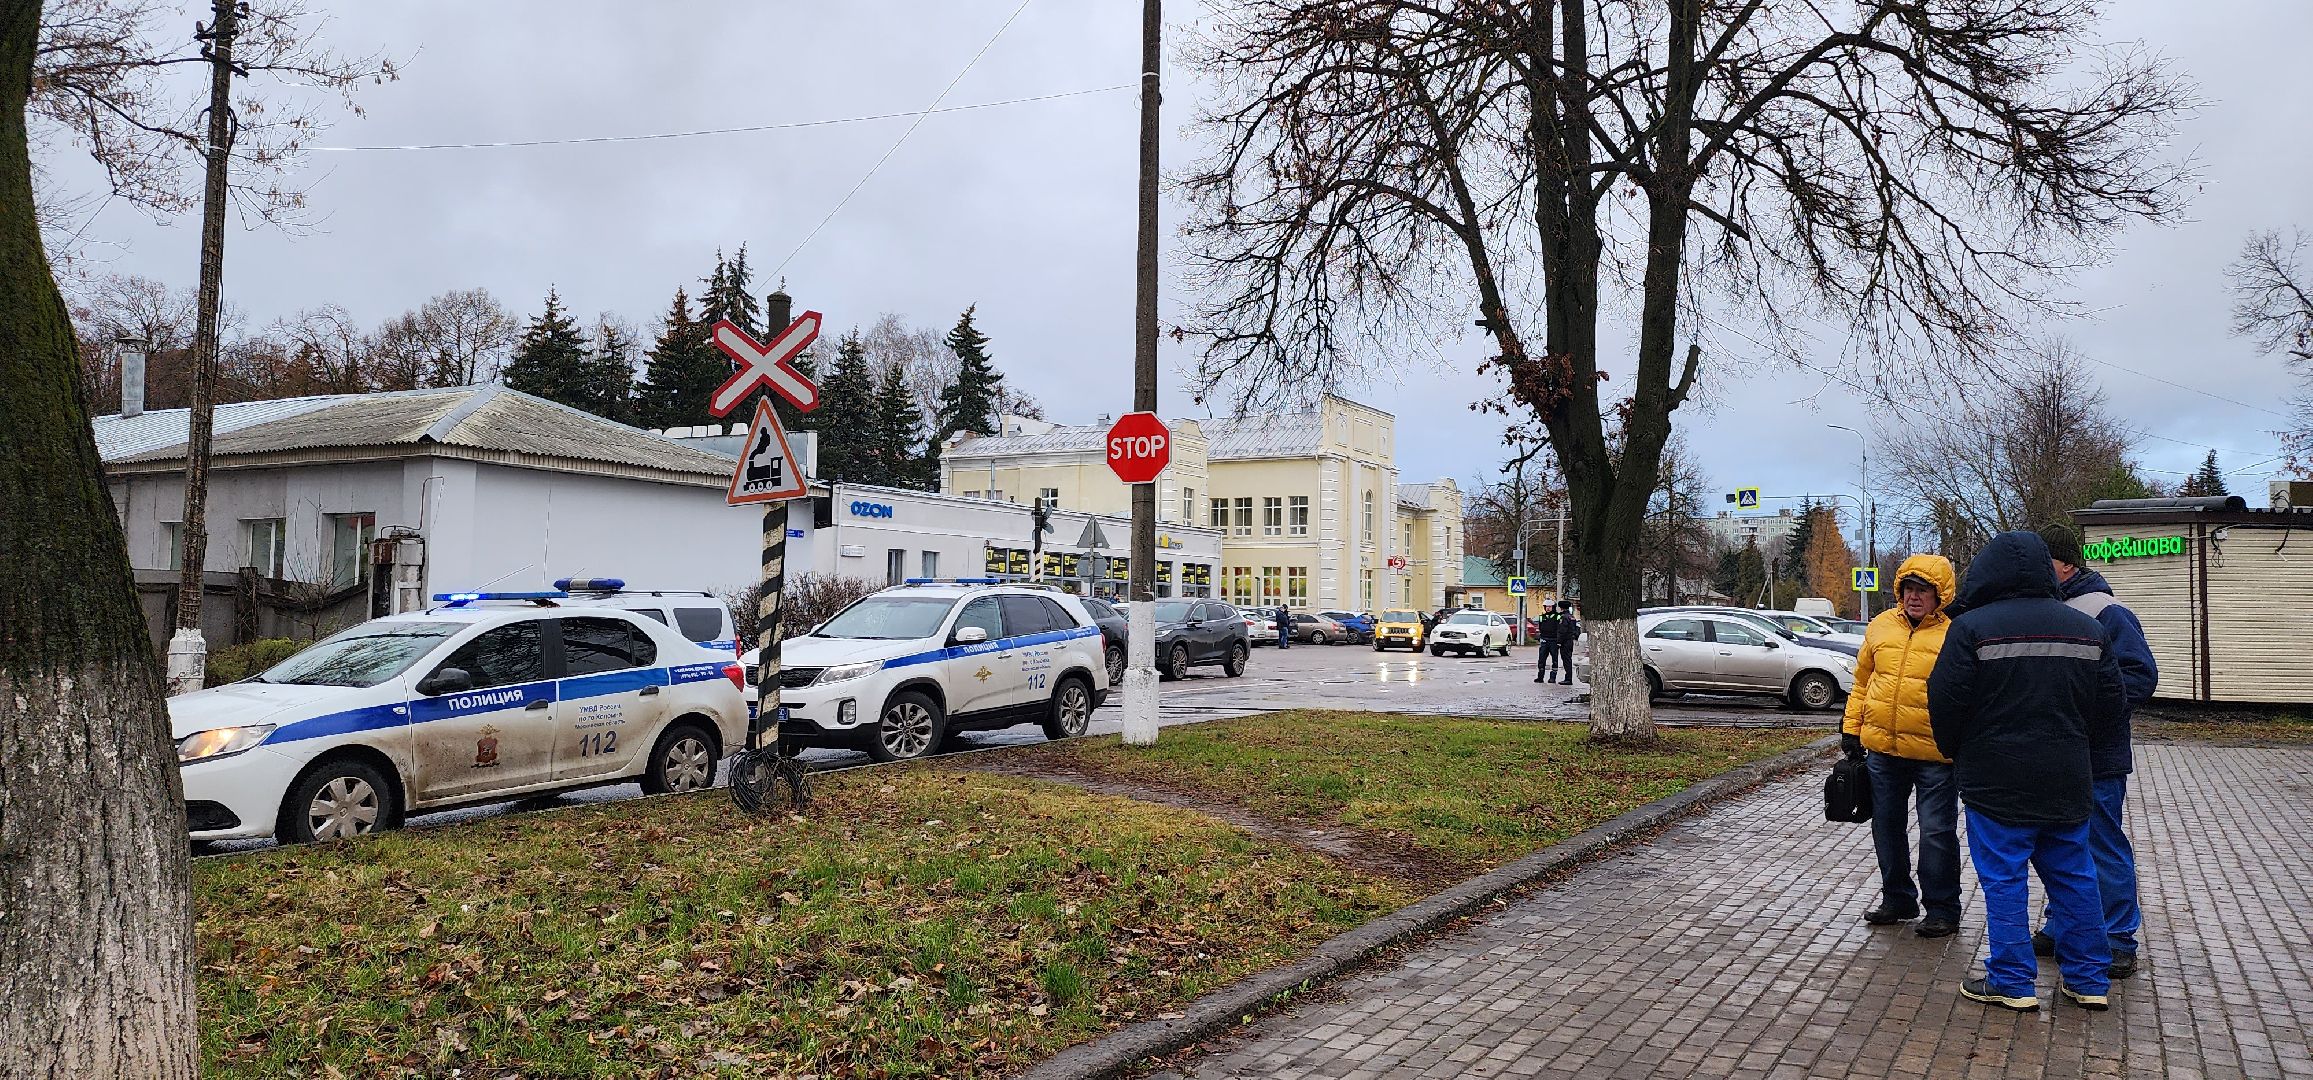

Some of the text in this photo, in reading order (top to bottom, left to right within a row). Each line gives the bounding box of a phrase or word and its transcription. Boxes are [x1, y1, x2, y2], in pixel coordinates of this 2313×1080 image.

[1110, 434, 1166, 460] STOP
[850, 500, 893, 519] OZON
[2083, 535, 2182, 564] кофе&шава
[963, 641, 999, 654] ПОЛИЦИЯ
[1027, 673, 1046, 691] 112
[448, 689, 524, 711] ПОЛИЦИЯ
[579, 705, 598, 713] УМВД
[579, 730, 617, 758] 112
